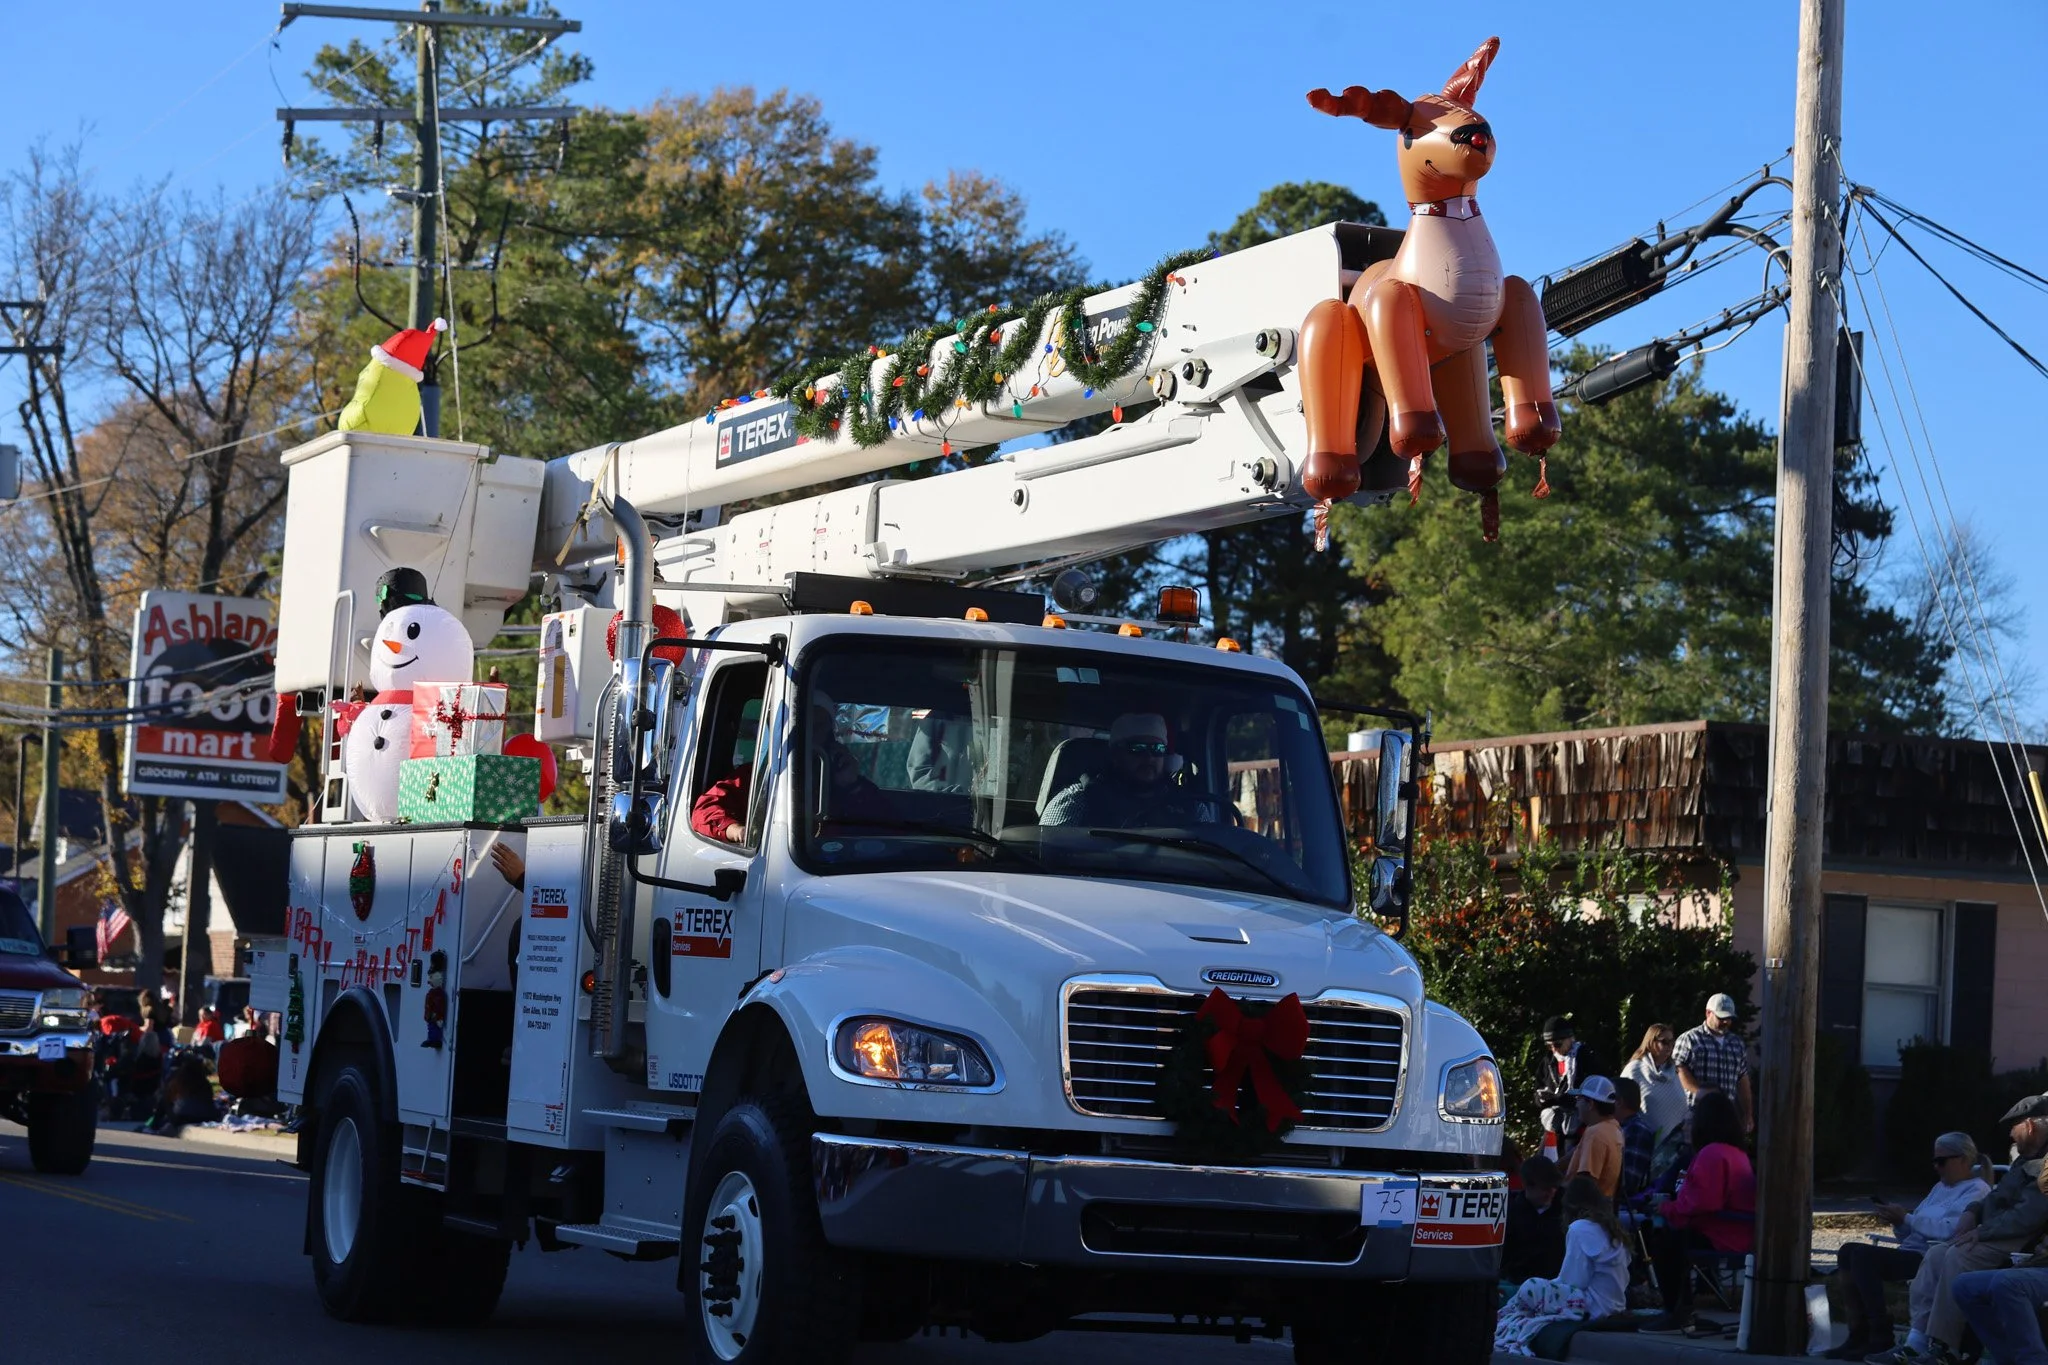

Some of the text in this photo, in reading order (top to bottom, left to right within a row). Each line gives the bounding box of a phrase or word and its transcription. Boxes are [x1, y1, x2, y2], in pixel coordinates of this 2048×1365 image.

[736, 410, 790, 452] TEREX
[163, 730, 256, 759] mart
[138, 766, 277, 786] GROCERY ATM LOTTERY
[540, 888, 566, 904] TEREX
[685, 907, 734, 944] TEREX
[1211, 971, 1273, 984] FREIGHTLINER
[668, 1072, 693, 1090] USDOT
[1376, 1190, 1405, 1215] 75
[1446, 1192, 1508, 1229] TEREX
[1416, 1228, 1453, 1241] Services
